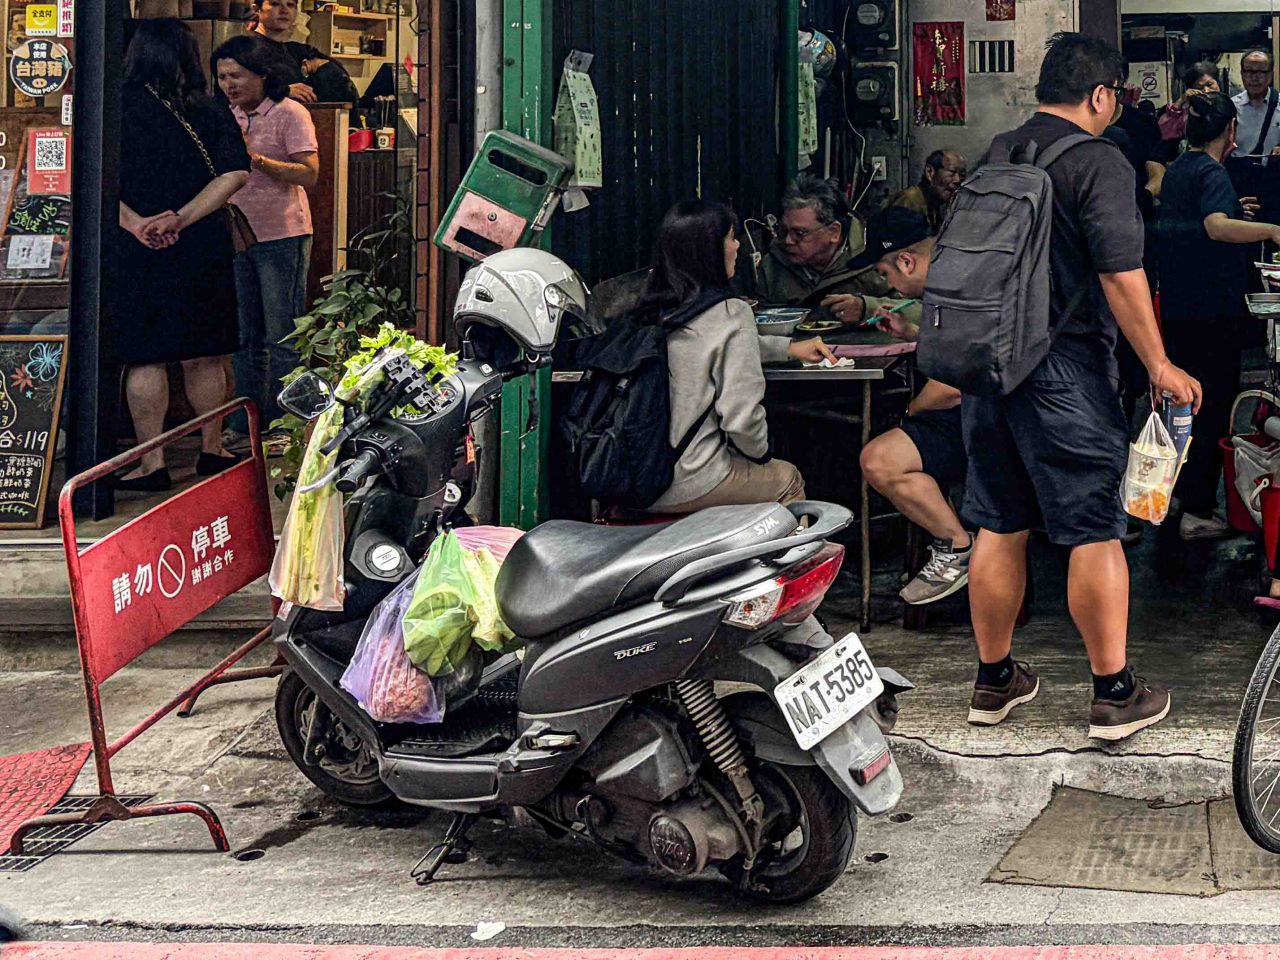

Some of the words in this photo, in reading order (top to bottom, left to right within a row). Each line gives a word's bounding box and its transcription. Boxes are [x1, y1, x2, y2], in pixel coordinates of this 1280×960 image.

[16, 61, 63, 77] 台灣豬
[754, 516, 779, 536] SYM
[112, 562, 153, 614] 請勿
[191, 515, 231, 562] 停車
[191, 549, 234, 585] 謝謝合作
[614, 642, 657, 660] DUKE
